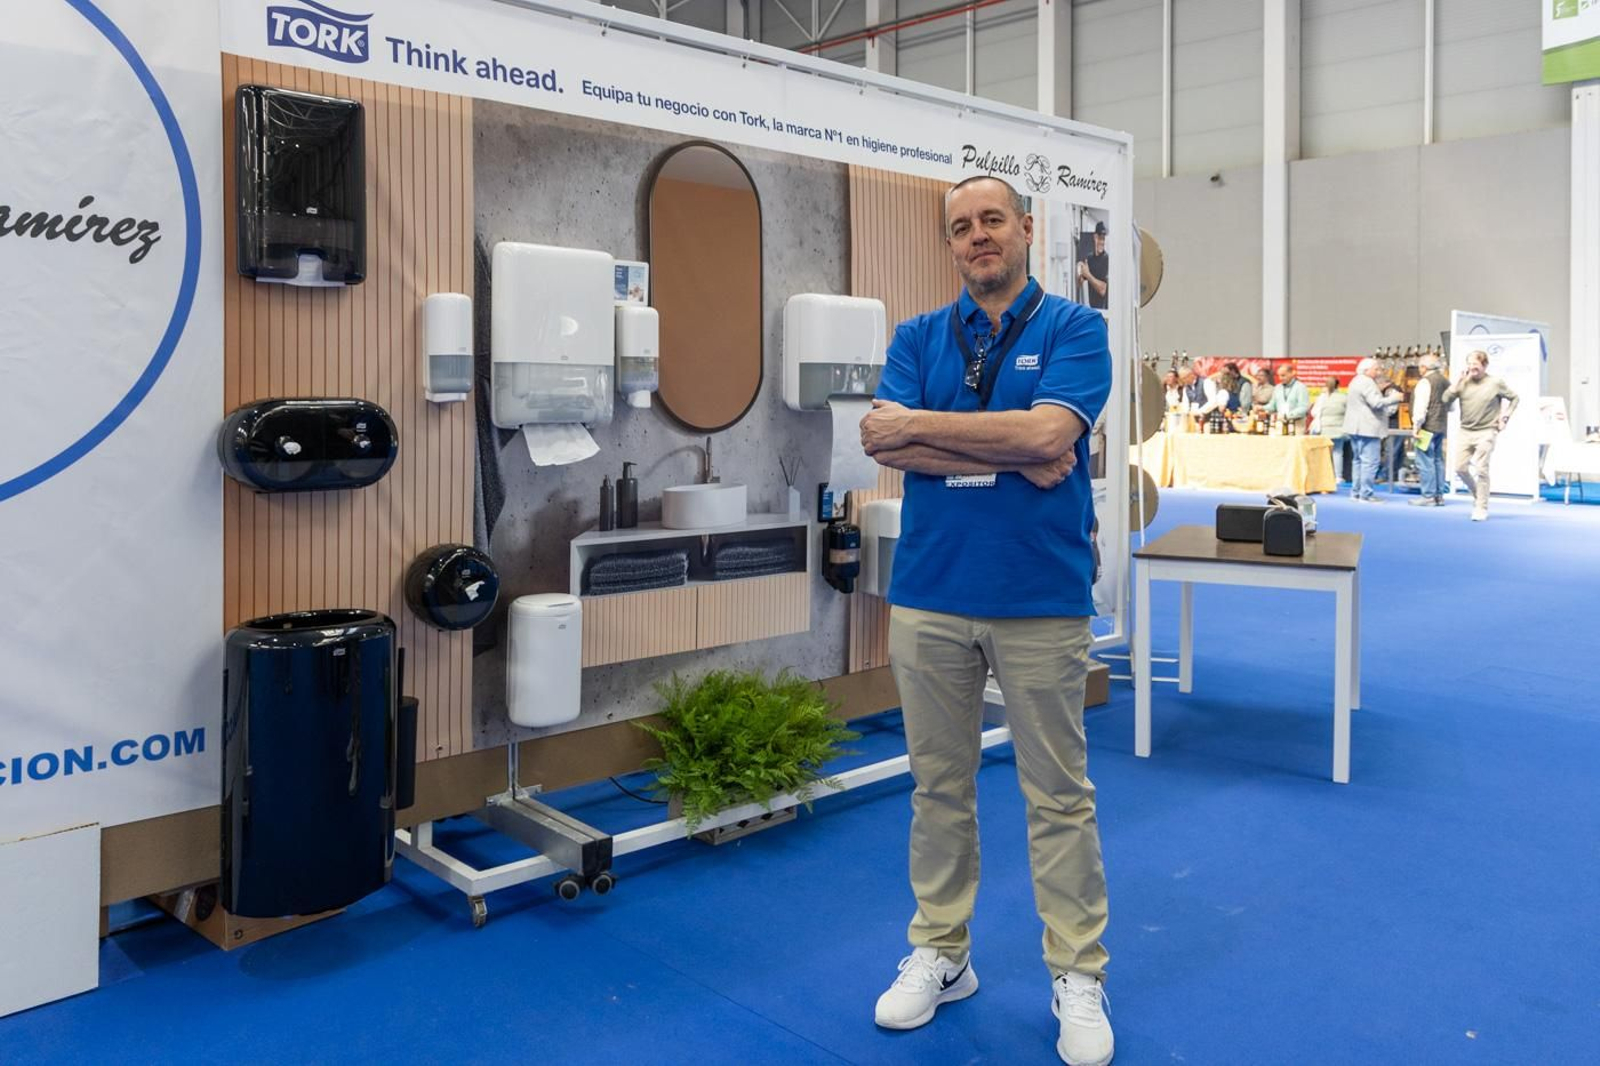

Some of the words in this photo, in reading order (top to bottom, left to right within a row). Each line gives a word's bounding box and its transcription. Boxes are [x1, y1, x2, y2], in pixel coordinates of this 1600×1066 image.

[271, 12, 365, 57] TORK
[385, 36, 468, 76] Think
[475, 57, 564, 94] ahead.
[582, 79, 633, 104] Equipa
[637, 91, 651, 107] tu
[655, 97, 709, 116] negocio
[713, 109, 737, 123] con
[739, 110, 770, 131] Tork,
[773, 118, 783, 132] la
[786, 123, 821, 140] marca
[846, 135, 859, 147] en
[862, 135, 898, 154] higiene
[900, 146, 953, 166] profesional
[962, 144, 1020, 177] Pulpillo
[1056, 165, 1109, 200] Ramírez
[0, 727, 206, 787] ION.COM
